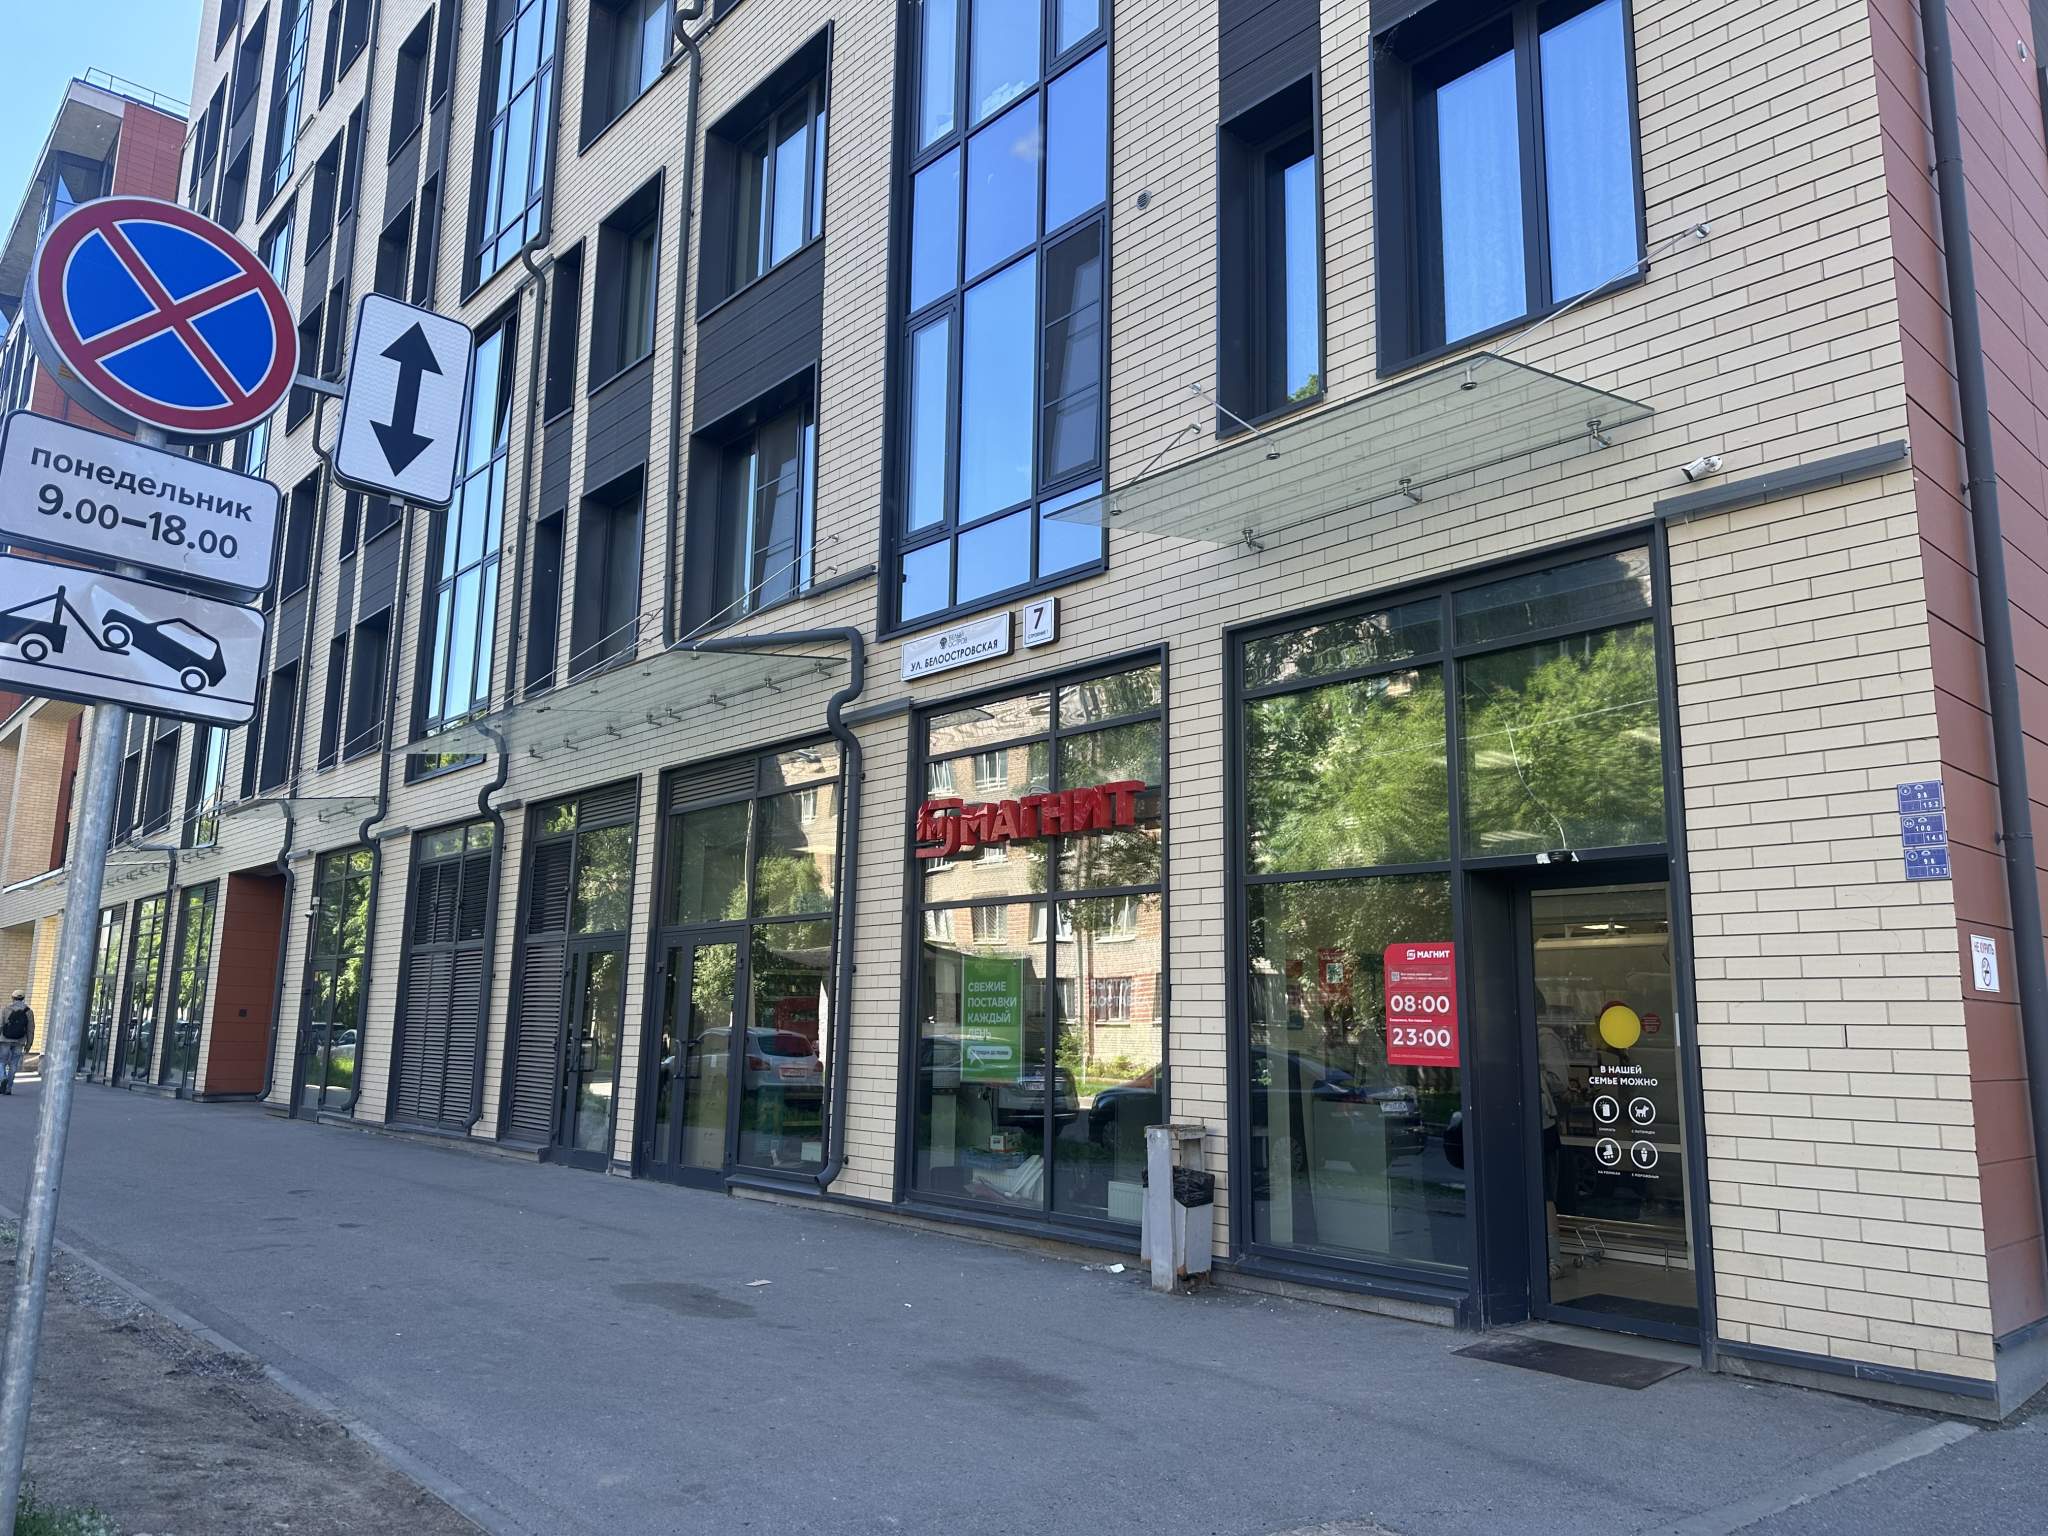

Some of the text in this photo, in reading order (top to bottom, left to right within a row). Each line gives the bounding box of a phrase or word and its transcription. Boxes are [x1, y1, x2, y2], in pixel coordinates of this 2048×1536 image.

[31, 447, 252, 521] понедельник
[1034, 606, 1043, 629] 7
[910, 639, 998, 672] УЛ. БЕЛООСТРОВСКАЯ
[960, 780, 1145, 845] МАГНИТ
[1417, 950, 1450, 959] МАГНИТ
[967, 981, 1007, 992] СВЕЖИЕ
[967, 996, 1017, 1008] ПОСТАВКИ
[1390, 995, 1450, 1013] 08:00
[967, 1010, 1011, 1024] КАЖДЫЙ
[1392, 1027, 1451, 1047] 23:00
[1600, 1064, 1642, 1074] В НАШЕЙ
[1589, 1076, 1658, 1087] СЕМЬЕ МОЖНО
